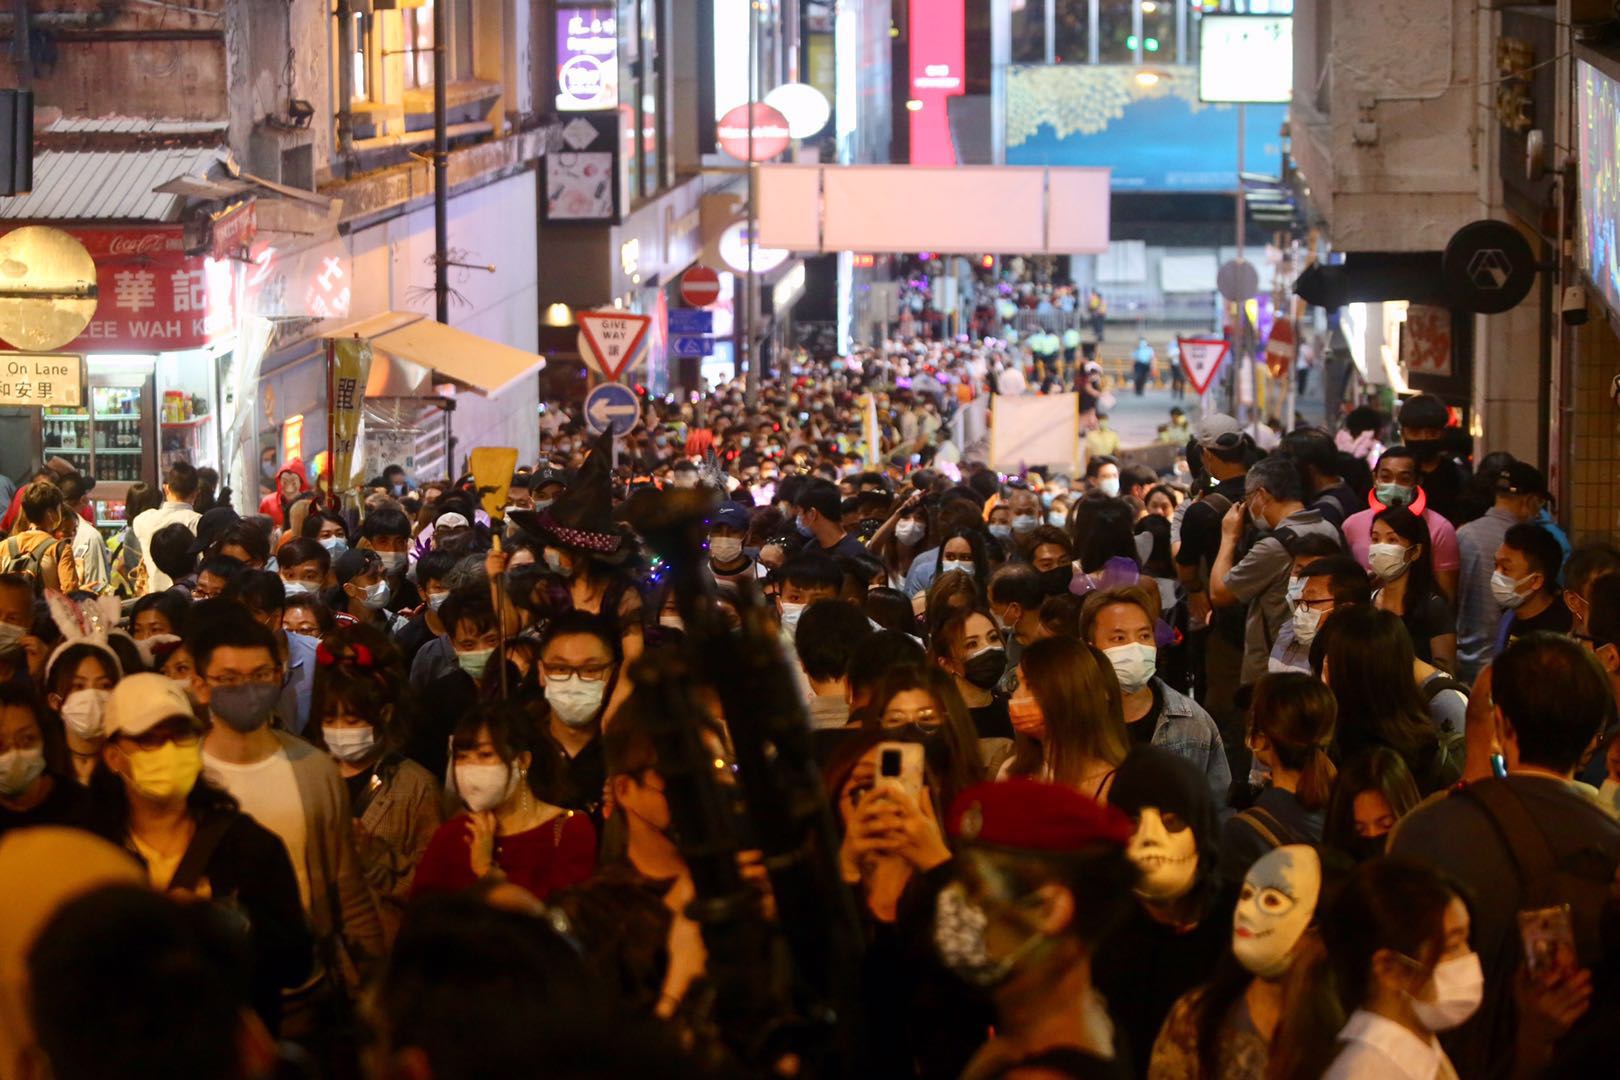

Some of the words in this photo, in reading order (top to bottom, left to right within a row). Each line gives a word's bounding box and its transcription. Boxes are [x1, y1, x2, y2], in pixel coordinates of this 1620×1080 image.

[128, 320, 182, 338] WAH
[602, 320, 626, 329] GIVE
[603, 331, 626, 339] WAY
[8, 361, 28, 374] On
[35, 362, 69, 375] Lane
[0, 381, 53, 398] 和安里
